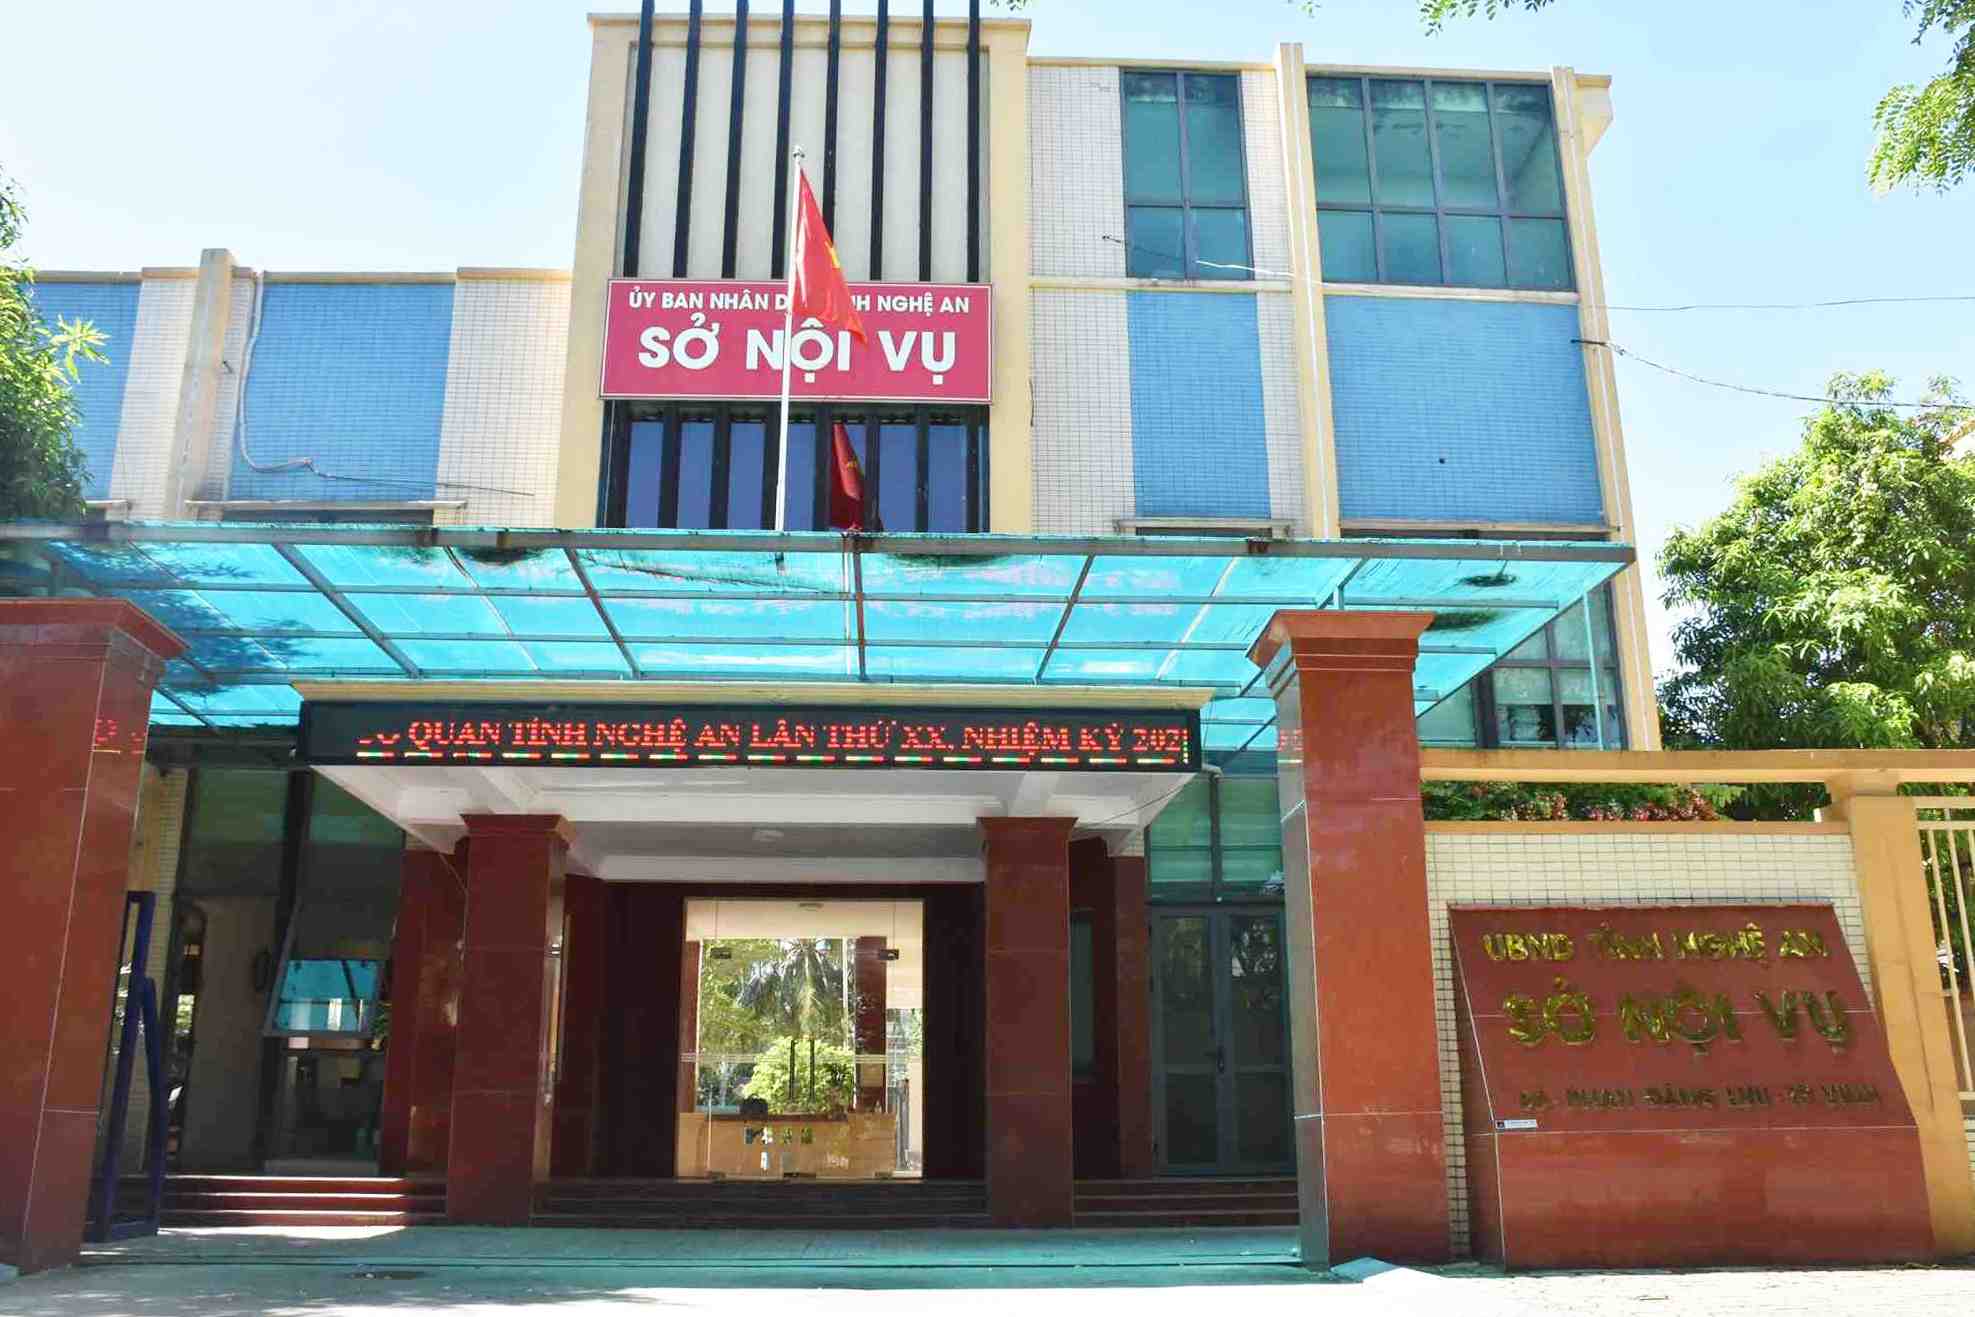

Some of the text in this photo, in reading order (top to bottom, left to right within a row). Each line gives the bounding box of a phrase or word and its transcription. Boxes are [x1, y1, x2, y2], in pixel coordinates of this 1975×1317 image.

[629, 285, 656, 309] ỦY
[661, 292, 704, 310] BAN
[709, 288, 770, 311] NHÂN
[877, 291, 934, 317] NGHỆ
[939, 296, 970, 314] AN
[638, 312, 957, 386] SỞ NỘI VỤ
[408, 719, 501, 751] QUAN
[693, 723, 740, 747] AN
